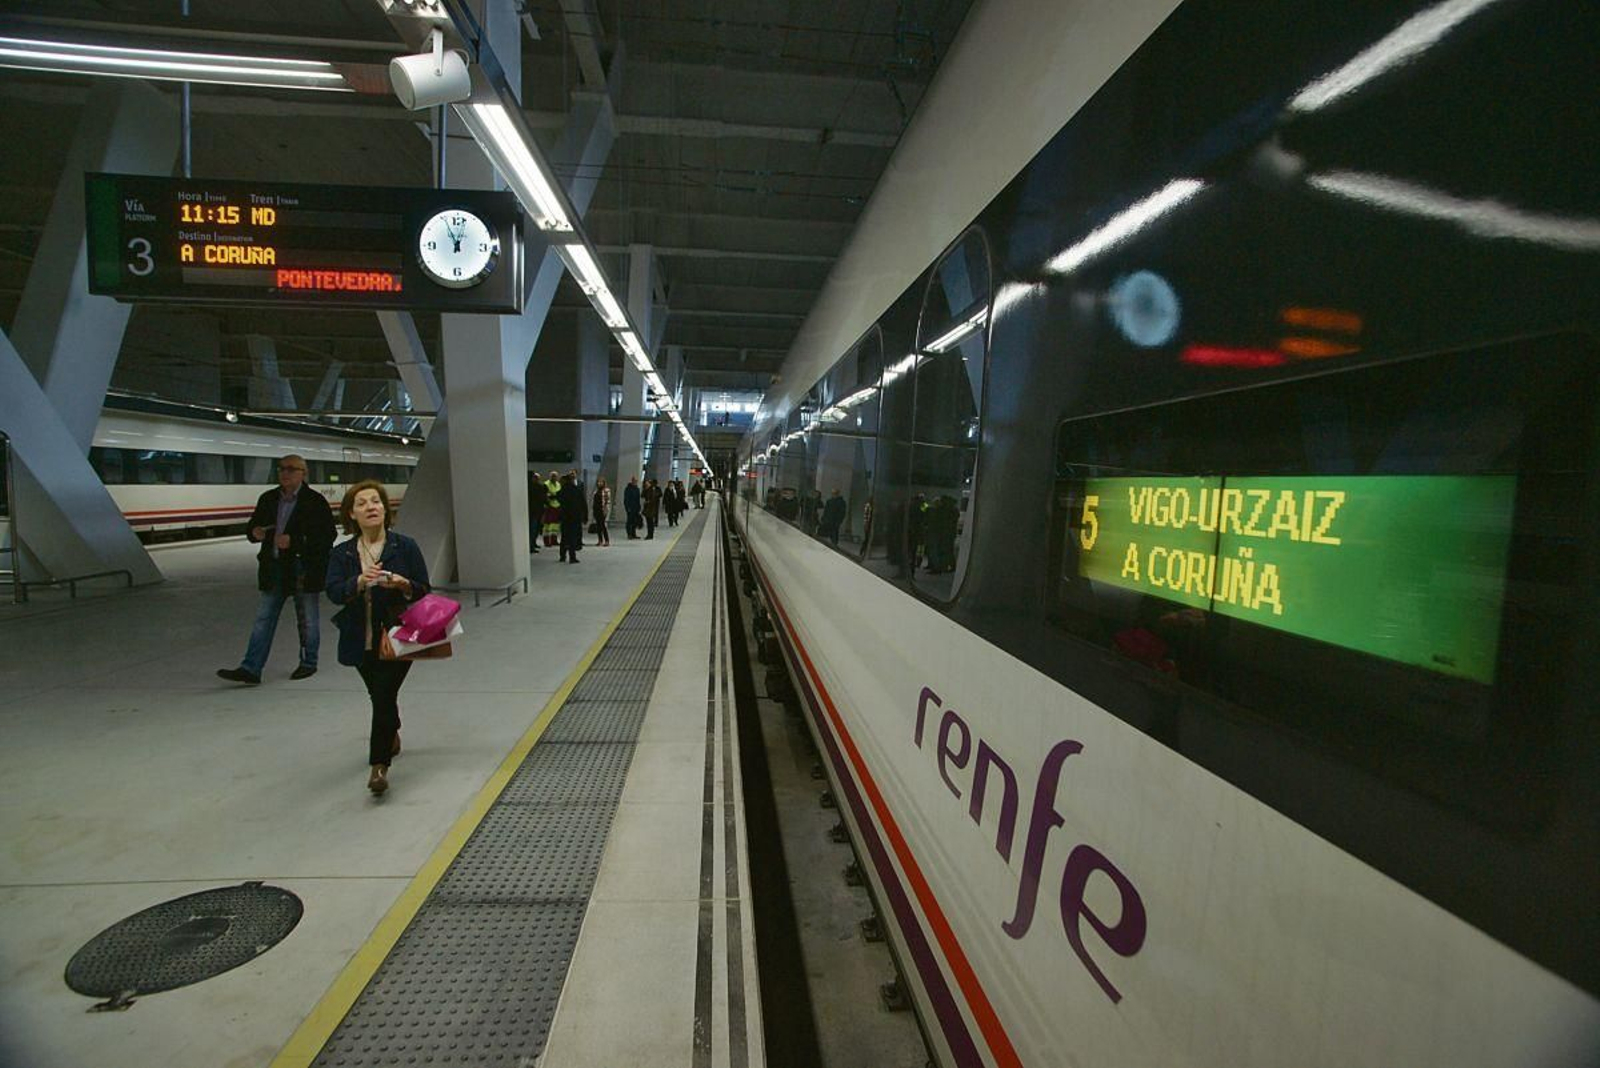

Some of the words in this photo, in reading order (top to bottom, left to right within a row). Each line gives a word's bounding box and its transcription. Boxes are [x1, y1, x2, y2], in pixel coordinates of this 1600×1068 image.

[178, 191, 202, 201] Hora
[250, 194, 273, 204] Tren
[181, 204, 240, 224] 11:15
[251, 207, 276, 226] MD
[178, 230, 212, 241] Destino
[428, 241, 437, 251] 9
[127, 237, 155, 276] 3
[181, 244, 194, 262] A
[204, 245, 276, 265] CORUÑA
[479, 243, 488, 253] 3
[453, 267, 462, 277] 6
[1080, 495, 1100, 550] 5
[1128, 486, 1346, 546] VIGO-URZAIZ
[1121, 542, 1140, 581] A
[1148, 545, 1283, 616] CORUÑA
[914, 686, 1148, 1006] renfe
